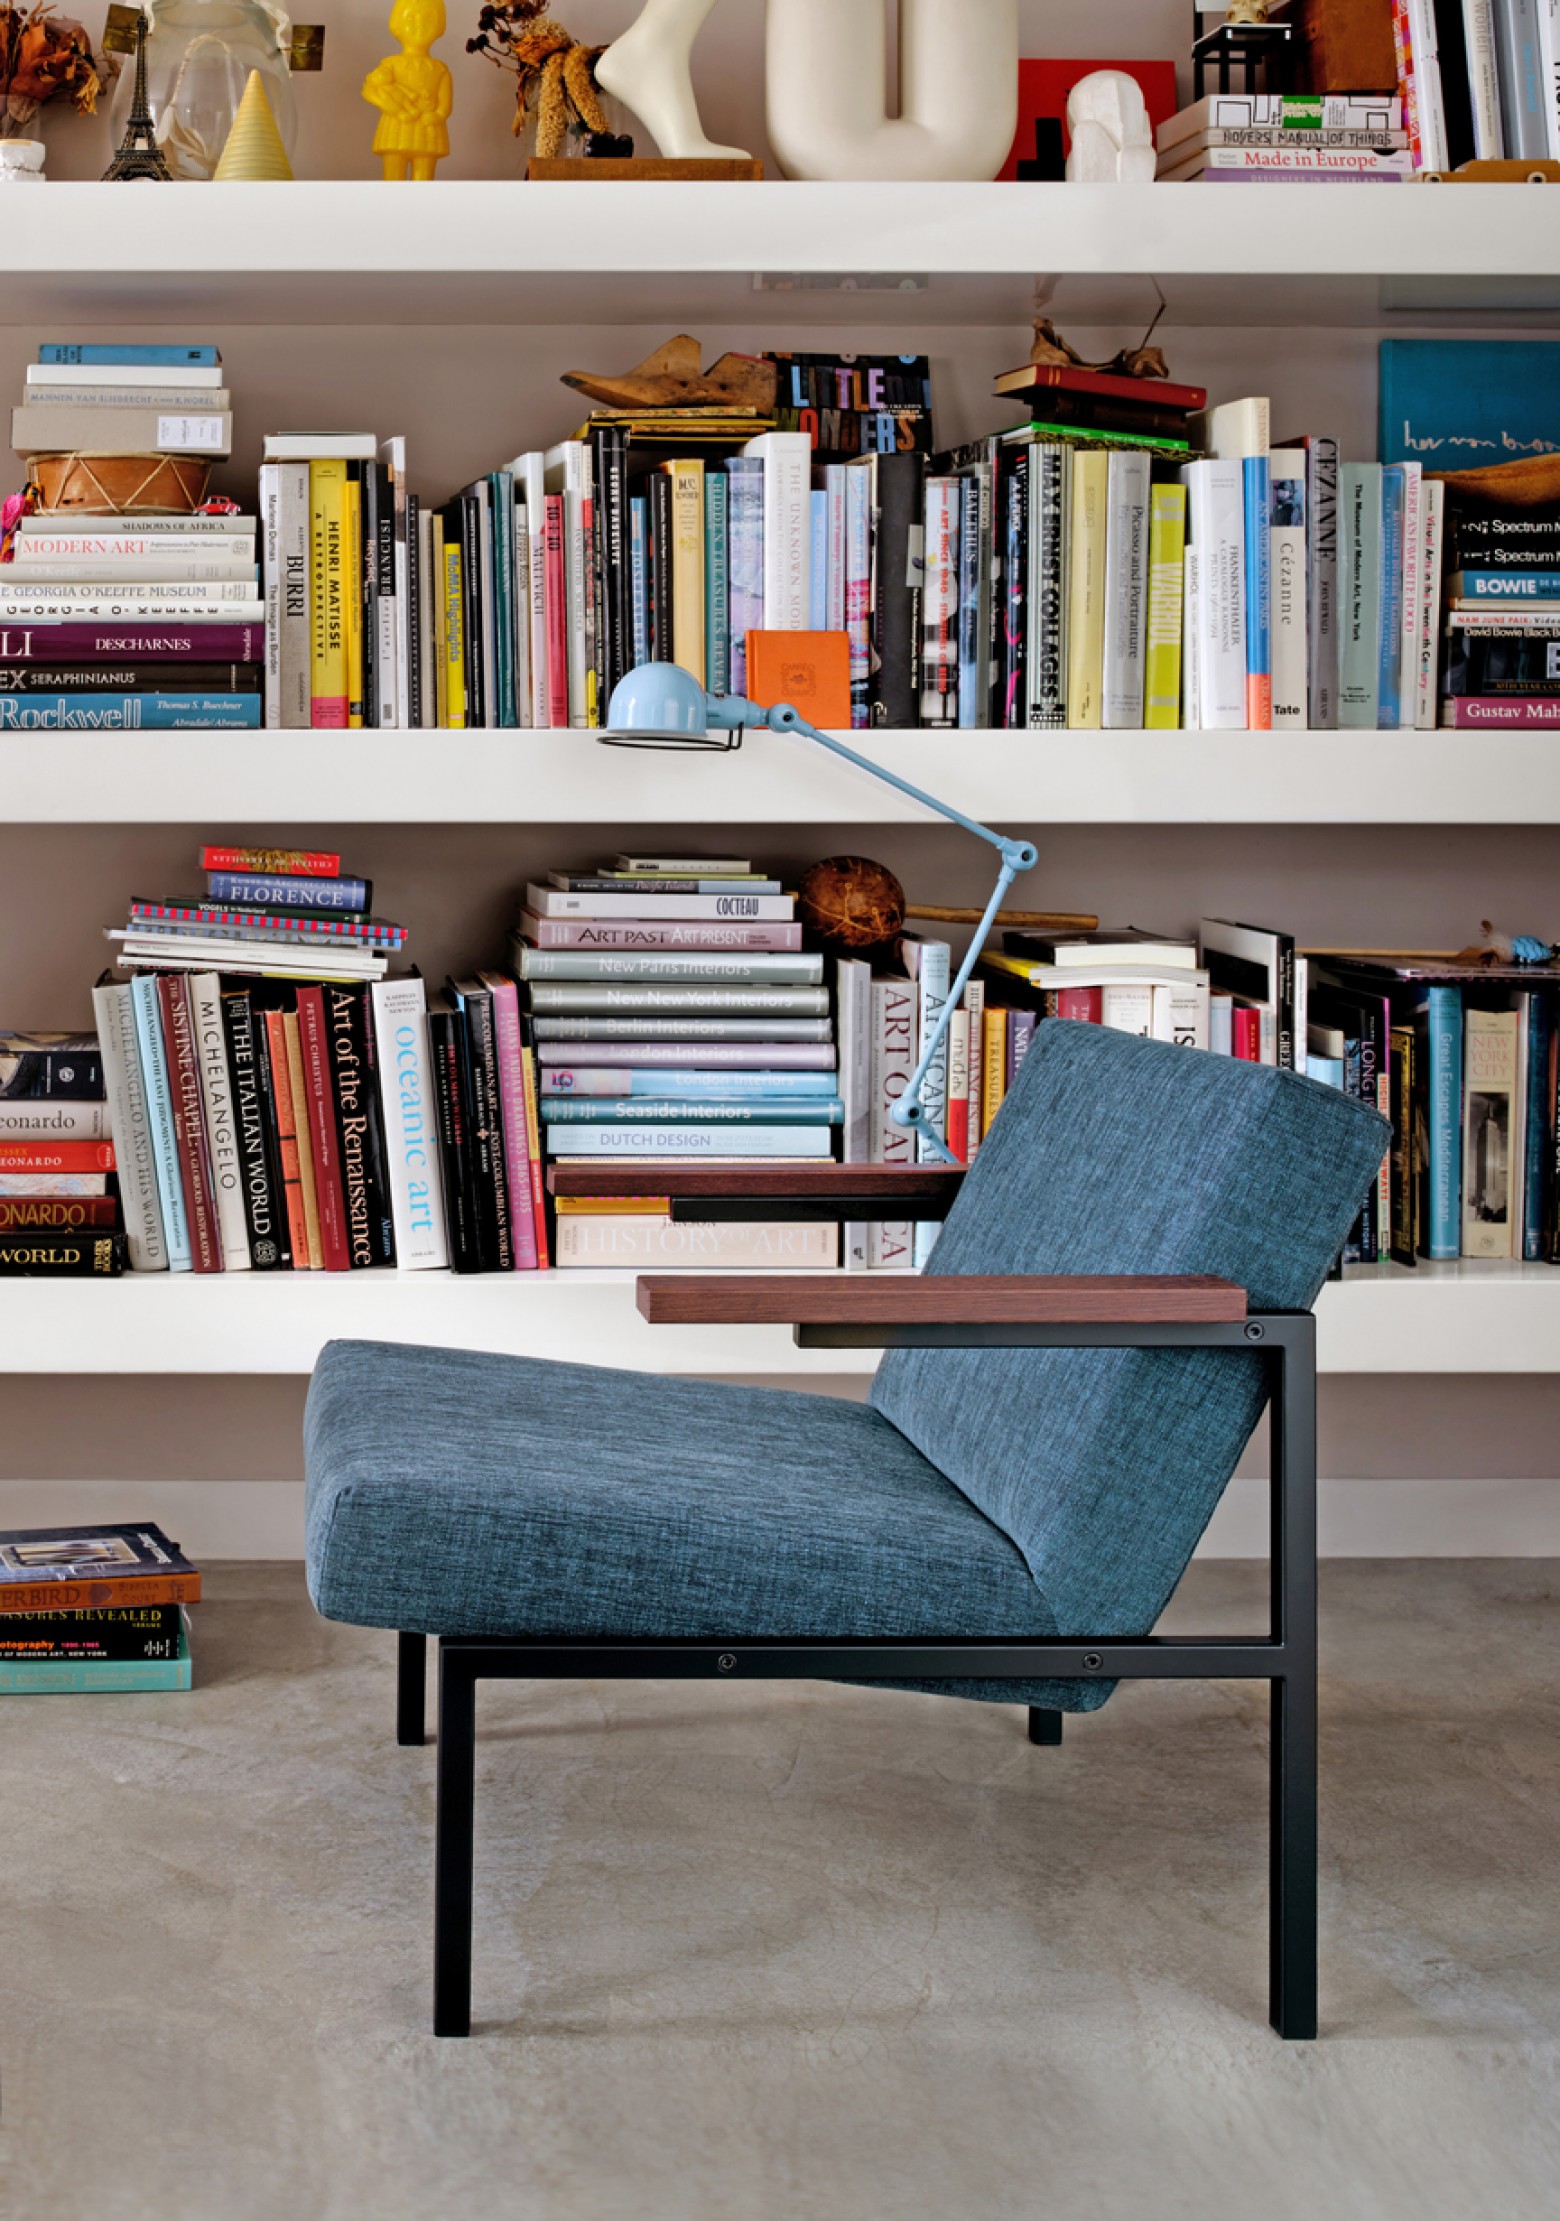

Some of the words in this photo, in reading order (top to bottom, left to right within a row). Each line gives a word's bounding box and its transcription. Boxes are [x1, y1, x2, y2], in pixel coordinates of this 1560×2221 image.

[1245, 152, 1291, 167] Made
[1295, 152, 1311, 166] in
[1316, 152, 1377, 171] Europe
[790, 463, 800, 494] THE
[1042, 454, 1060, 507] MAX
[1354, 484, 1362, 499] The
[268, 494, 277, 528] Marlene
[1314, 438, 1336, 562] CEZANNE
[940, 509, 948, 530] ART
[1131, 505, 1144, 553] Picasso
[1354, 502, 1362, 536] Museum
[1426, 516, 1436, 546] Visual
[1492, 520, 1552, 534] Spectrum
[23, 540, 106, 554] MODERN
[110, 540, 149, 554] ART
[268, 530, 277, 562] Dumas
[328, 521, 340, 572] HENRI
[790, 503, 801, 586] UNKNOWN
[1042, 514, 1060, 584] ERNST
[1424, 548, 1434, 568] Arts
[1494, 549, 1554, 563] Spectrum
[448, 553, 460, 596] MoMA
[1130, 556, 1142, 580] and
[1190, 554, 1198, 596] WARHOL
[1354, 550, 1362, 580] Modern
[14, 586, 76, 596] GEORGIA
[150, 586, 207, 596] MUSEUM
[268, 584, 278, 600] The
[286, 554, 304, 618] BURRI
[713, 551, 724, 627] TREASURES
[1230, 544, 1239, 646] FRANKENTHALER
[1279, 542, 1296, 626] Cézanne
[1423, 583, 1433, 599] the
[1475, 579, 1537, 594] BOWIE
[268, 602, 278, 632] Image
[329, 579, 340, 650] MATISSE
[1128, 585, 1142, 659] Portraiture
[1150, 562, 1183, 650] WARHOL
[1353, 602, 1361, 620] New
[1404, 597, 1415, 634] FOOD
[95, 638, 191, 651] DESCHARNES
[447, 598, 461, 662] Highlights
[1040, 589, 1059, 698] COLLAGES
[1352, 622, 1361, 642] York
[268, 644, 278, 676] Burden
[1419, 651, 1431, 690] Century
[0, 699, 141, 729] Rockwell
[1273, 705, 1300, 716] Tate
[1466, 703, 1522, 718] Gustav
[230, 886, 343, 906] FLORENCE
[716, 897, 759, 916] COCTEAU
[578, 928, 622, 943] ART
[624, 930, 669, 943] PAST
[671, 928, 699, 944] ART
[700, 930, 750, 945] PRESENT
[600, 959, 635, 973] New
[640, 960, 679, 974] Paris
[682, 960, 751, 975] Interiors
[306, 1002, 318, 1042] PETRUS
[330, 989, 356, 1033] Art
[884, 988, 912, 1063] ART
[171, 1001, 193, 1070] SISTINE
[232, 1020, 254, 1064] THE
[336, 1038, 360, 1065] of
[1440, 1032, 1453, 1068] Great
[1472, 1035, 1509, 1049] NEW
[1361, 1041, 1375, 1091] LONG
[1469, 1049, 1512, 1063] YORK
[1472, 1064, 1510, 1078] CITY
[338, 1070, 362, 1110] the
[988, 1039, 1000, 1115] TREASURES
[179, 1071, 202, 1148] CHAPEL:
[200, 1001, 237, 1190] MICHELANGELO
[238, 1070, 262, 1154] ITALIAN
[394, 1026, 436, 1168] oceanic
[615, 1103, 679, 1118] Seaside
[682, 1103, 751, 1119] Interiors
[1437, 1072, 1452, 1126] Escapes
[133, 1130, 150, 1164] AND
[600, 1133, 653, 1147] DUTCH
[656, 1134, 711, 1147] DESIGN
[342, 1115, 374, 1266] Renaissance
[1439, 1128, 1453, 1223] Mediterranean
[248, 1160, 271, 1235] WORLD
[407, 1180, 434, 1232] art
[141, 1200, 160, 1258] WORLD
[380, 1217, 392, 1256] Abrams
[580, 1226, 720, 1255] HISTORY
[751, 1227, 817, 1255] ART
[498, 1228, 510, 1267] WORLD
[75, 1610, 162, 1621] REVEALED
